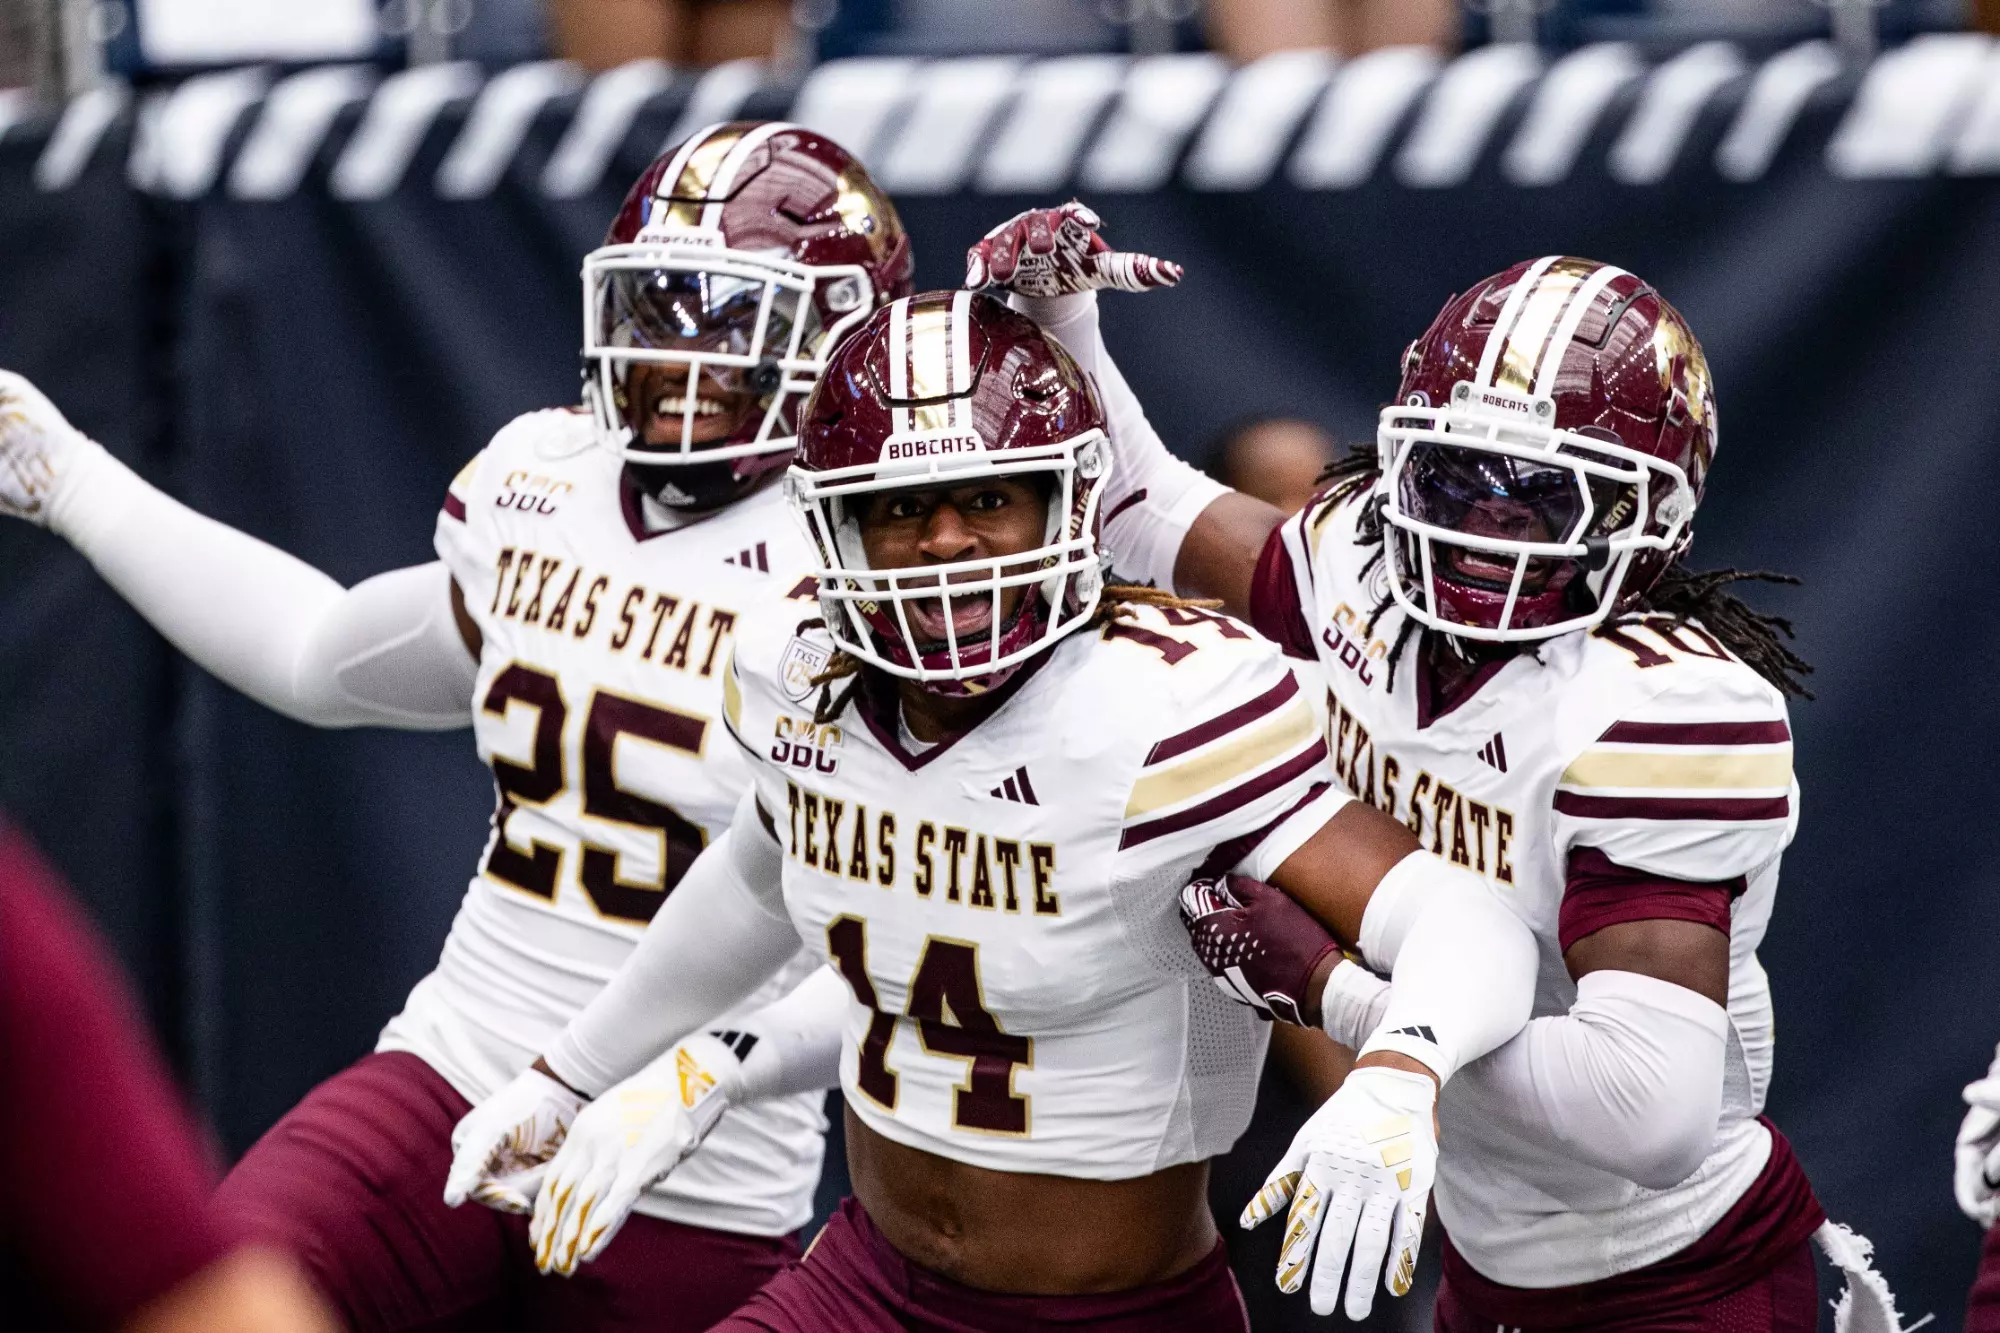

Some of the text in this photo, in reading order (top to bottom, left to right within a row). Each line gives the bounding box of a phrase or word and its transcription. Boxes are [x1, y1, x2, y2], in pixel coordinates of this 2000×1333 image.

[888, 436, 977, 460] BOBCATS
[1482, 393, 1529, 413] BOBCATS
[490, 546, 738, 678] TEXAS STAT
[794, 647, 821, 668] TXST
[481, 658, 713, 929] 25
[786, 779, 1063, 918] TEXAS STATE
[1323, 683, 1516, 889] TEXAS STATE
[824, 911, 1036, 1132] 14
